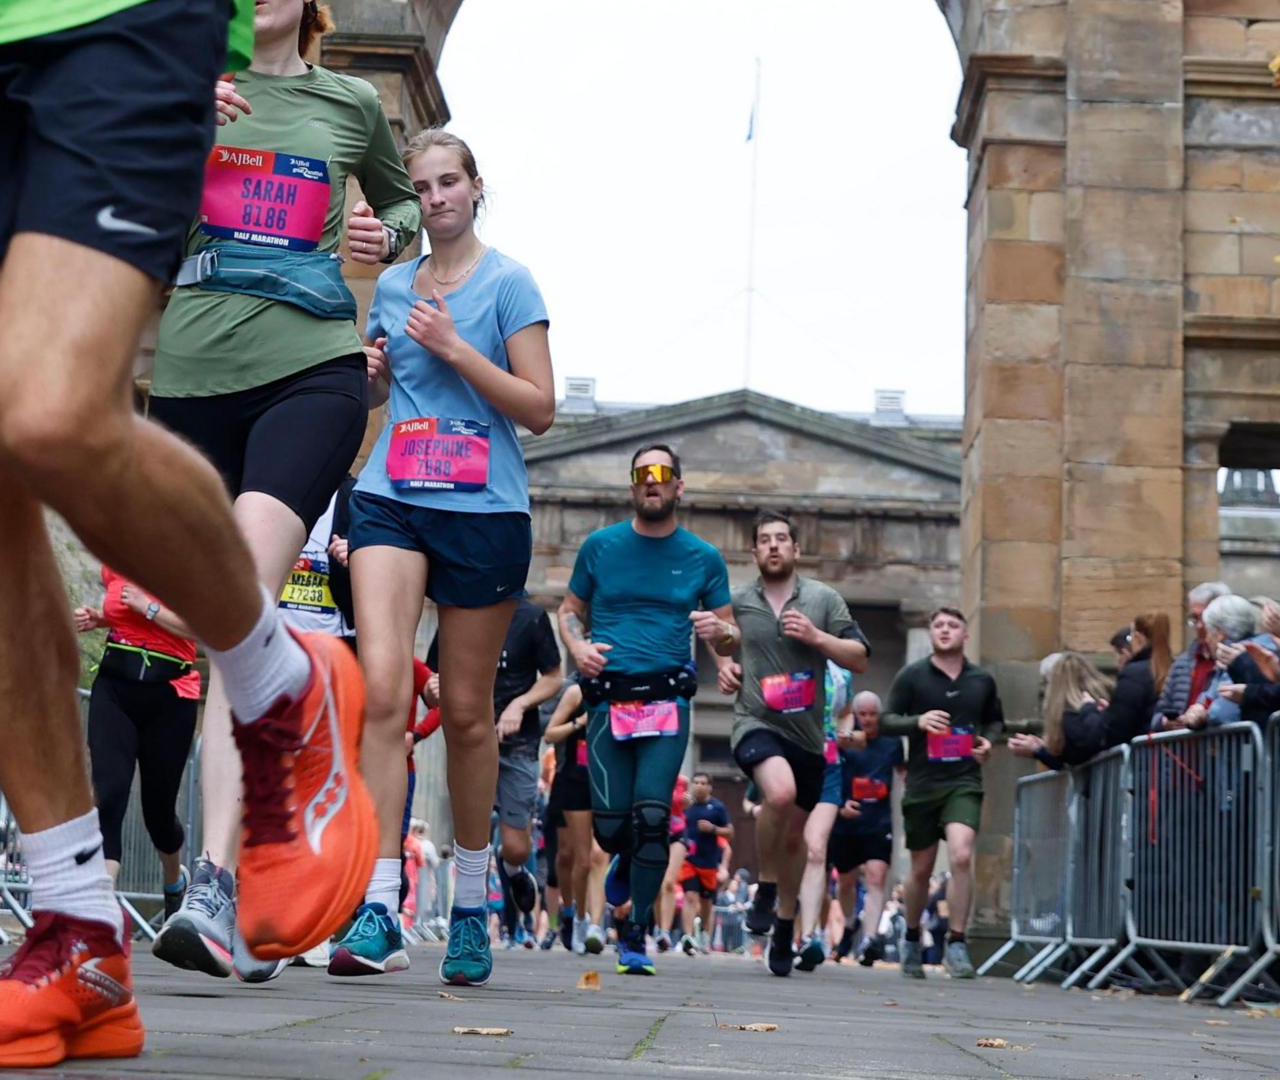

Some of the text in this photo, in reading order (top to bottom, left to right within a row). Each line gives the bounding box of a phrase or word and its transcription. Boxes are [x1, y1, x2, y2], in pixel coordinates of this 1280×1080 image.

[228, 152, 263, 168] AJBell
[240, 177, 297, 206] SARAH
[241, 204, 288, 230] 8186
[233, 231, 289, 246] HALF MARATHON
[400, 439, 473, 458] JOSEPHINE
[288, 587, 323, 602] 17238
